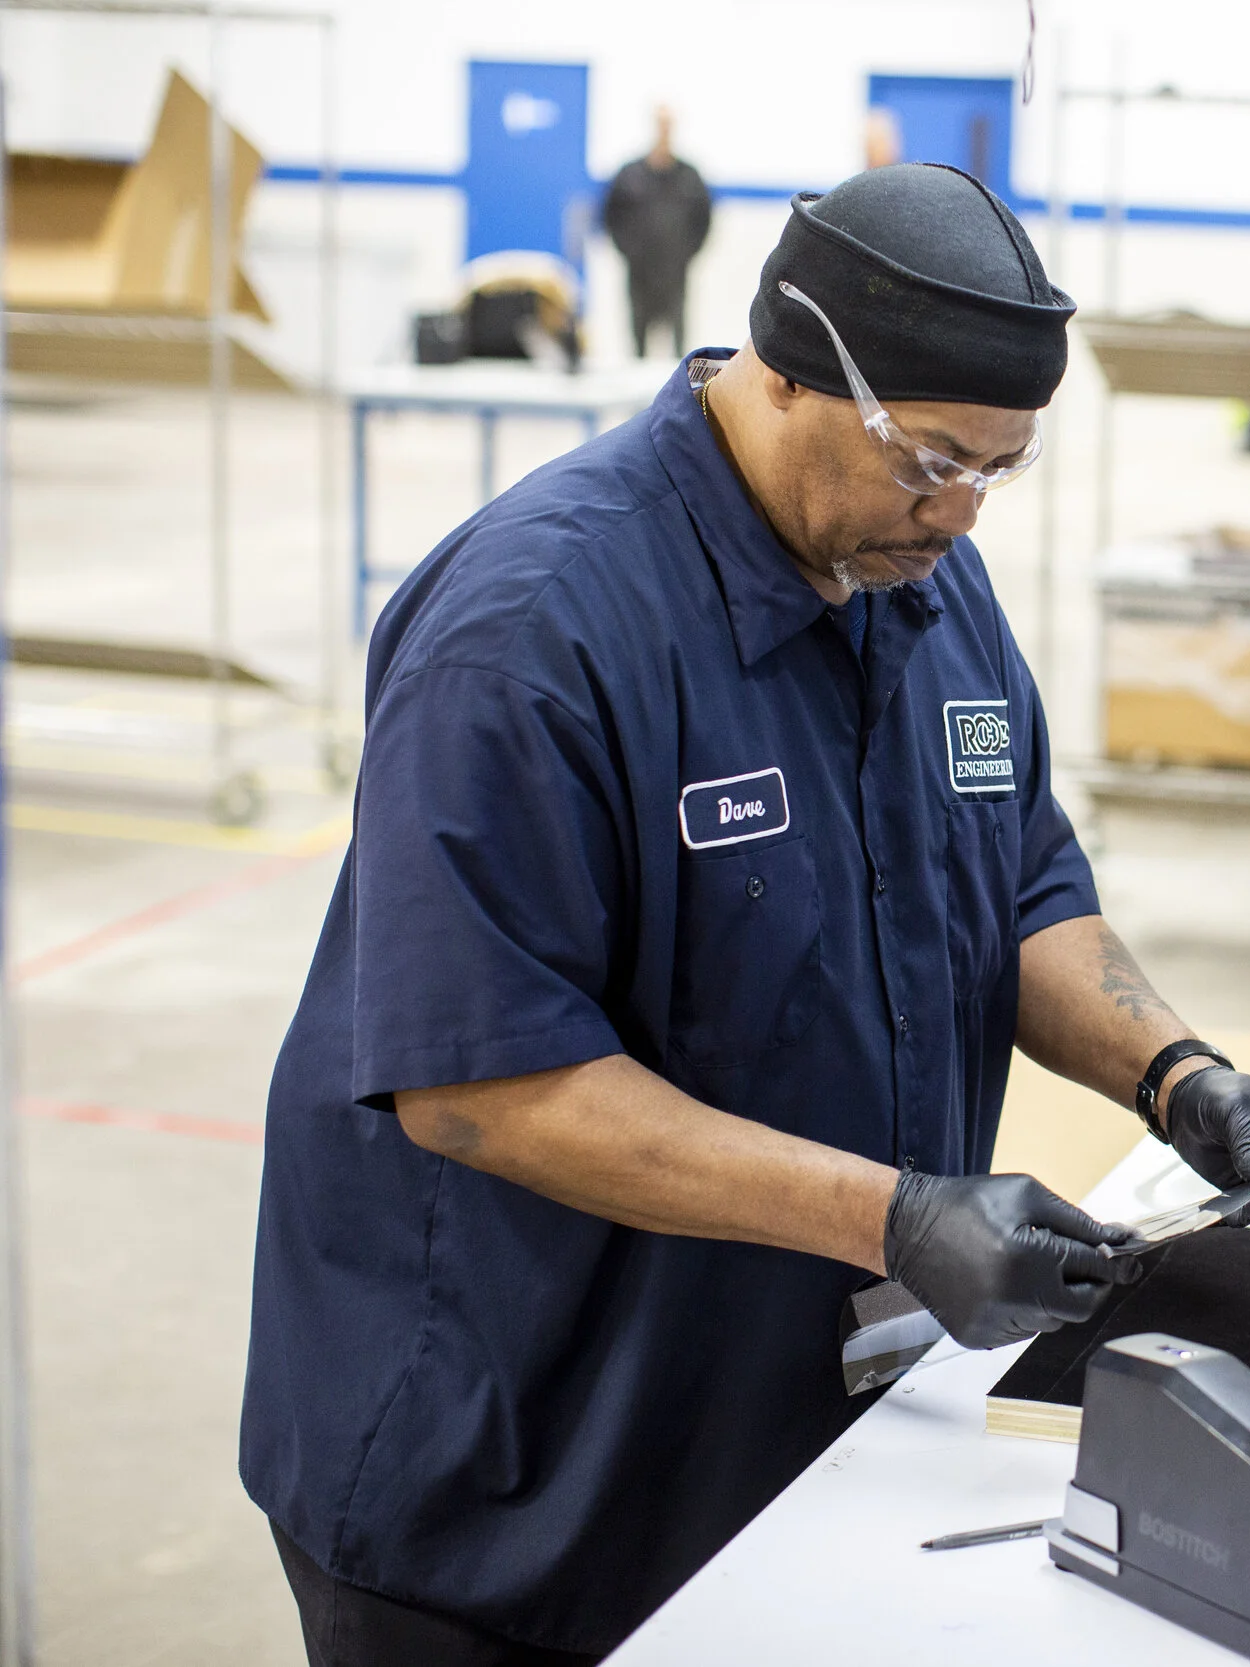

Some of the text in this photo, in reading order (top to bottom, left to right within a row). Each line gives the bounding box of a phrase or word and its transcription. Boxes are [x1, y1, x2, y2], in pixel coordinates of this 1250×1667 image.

[956, 760, 1013, 778] ENGINEERIN
[718, 797, 766, 824] Dave
[1138, 1510, 1230, 1572] BOSTITCH
